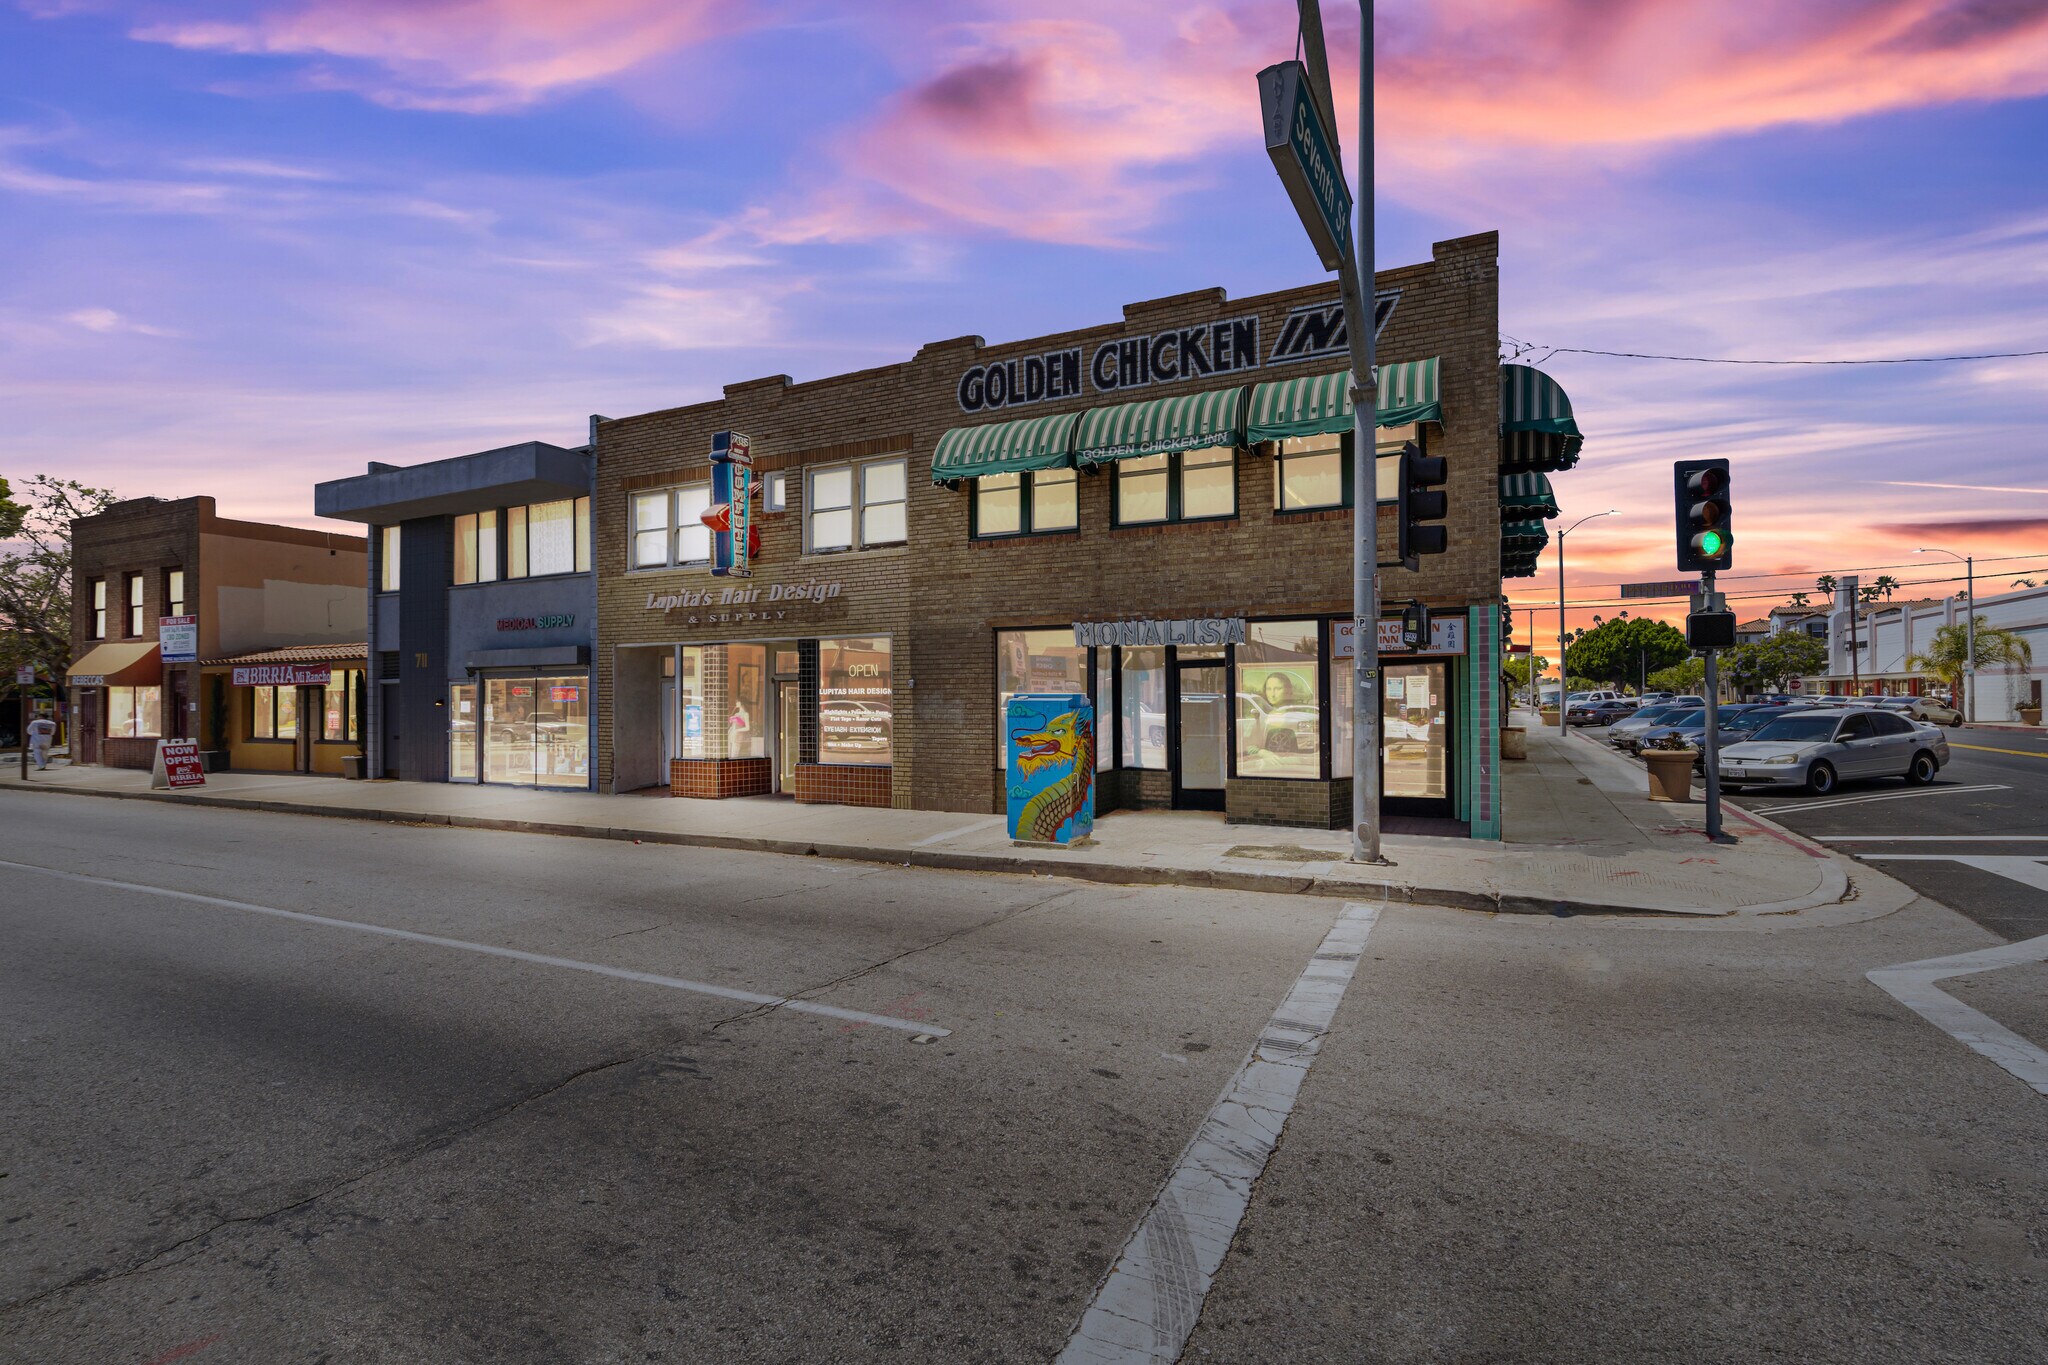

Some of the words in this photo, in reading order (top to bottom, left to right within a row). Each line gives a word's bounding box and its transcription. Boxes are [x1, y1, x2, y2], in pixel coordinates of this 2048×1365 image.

[1296, 102, 1335, 213] Seventh
[1335, 200, 1346, 240] St
[958, 347, 1083, 413] GOLDEN
[1090, 314, 1261, 392] CHICKEN
[1083, 444, 1135, 459] GOLDEN
[1140, 435, 1199, 452] CHICKEN
[1204, 431, 1229, 444] INN
[645, 588, 714, 613] Lupita's
[720, 584, 763, 605] Hair
[768, 578, 842, 604] Design
[496, 618, 537, 631] MEDICAL
[537, 614, 575, 629] SUPPLY
[688, 616, 699, 624] &
[709, 611, 787, 623] SUPPLY
[1072, 618, 1246, 647] MONALISA
[1379, 636, 1399, 644] INN
[249, 666, 295, 684] BIRRIA
[295, 671, 305, 683] Mi
[305, 670, 331, 682] Rancho
[848, 664, 879, 677] OPEN
[866, 687, 893, 695] DESIGN
[165, 746, 194, 755] NOW
[165, 756, 199, 765] OPEN
